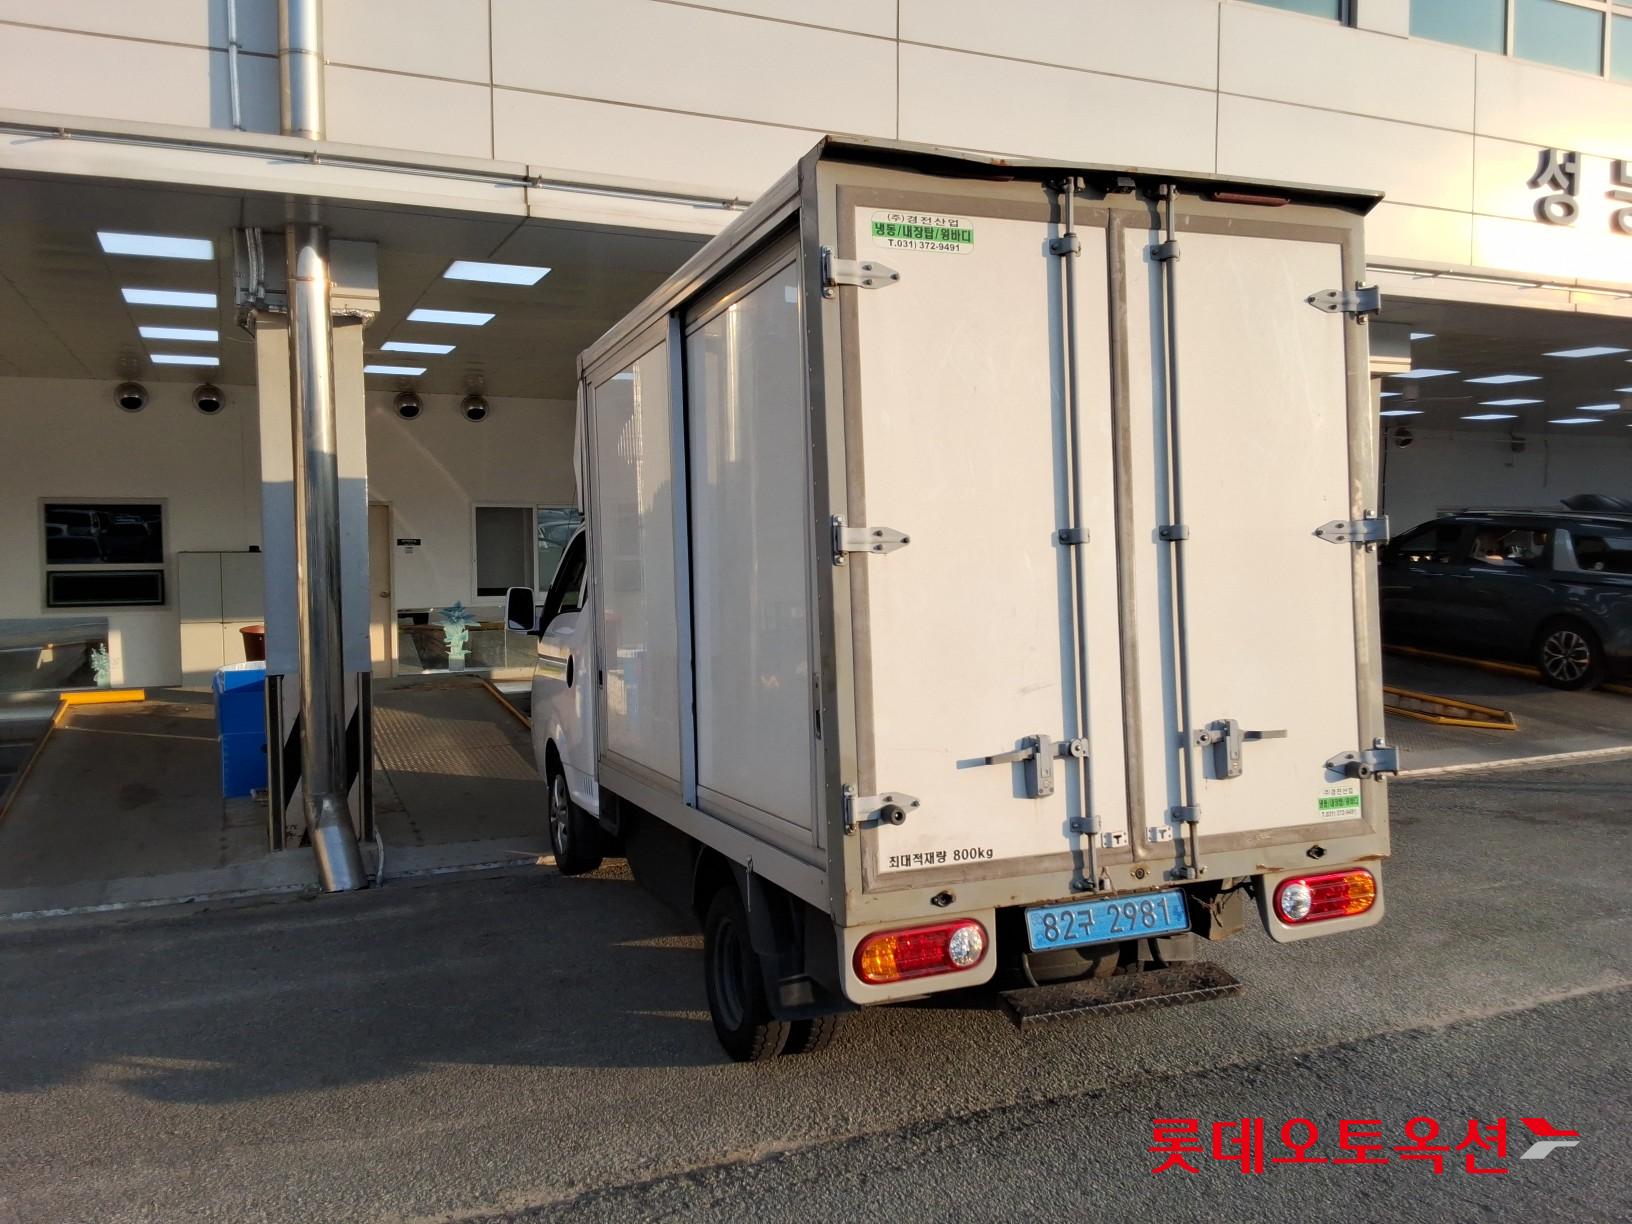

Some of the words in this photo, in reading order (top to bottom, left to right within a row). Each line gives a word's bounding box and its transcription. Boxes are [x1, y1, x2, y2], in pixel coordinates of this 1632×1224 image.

[919, 241, 960, 252] 372-9491
[889, 850, 947, 868] 최대적재량
[953, 847, 993, 861] 800kg
[1043, 908, 1096, 942] 82구
[1107, 896, 1171, 934] 2981
